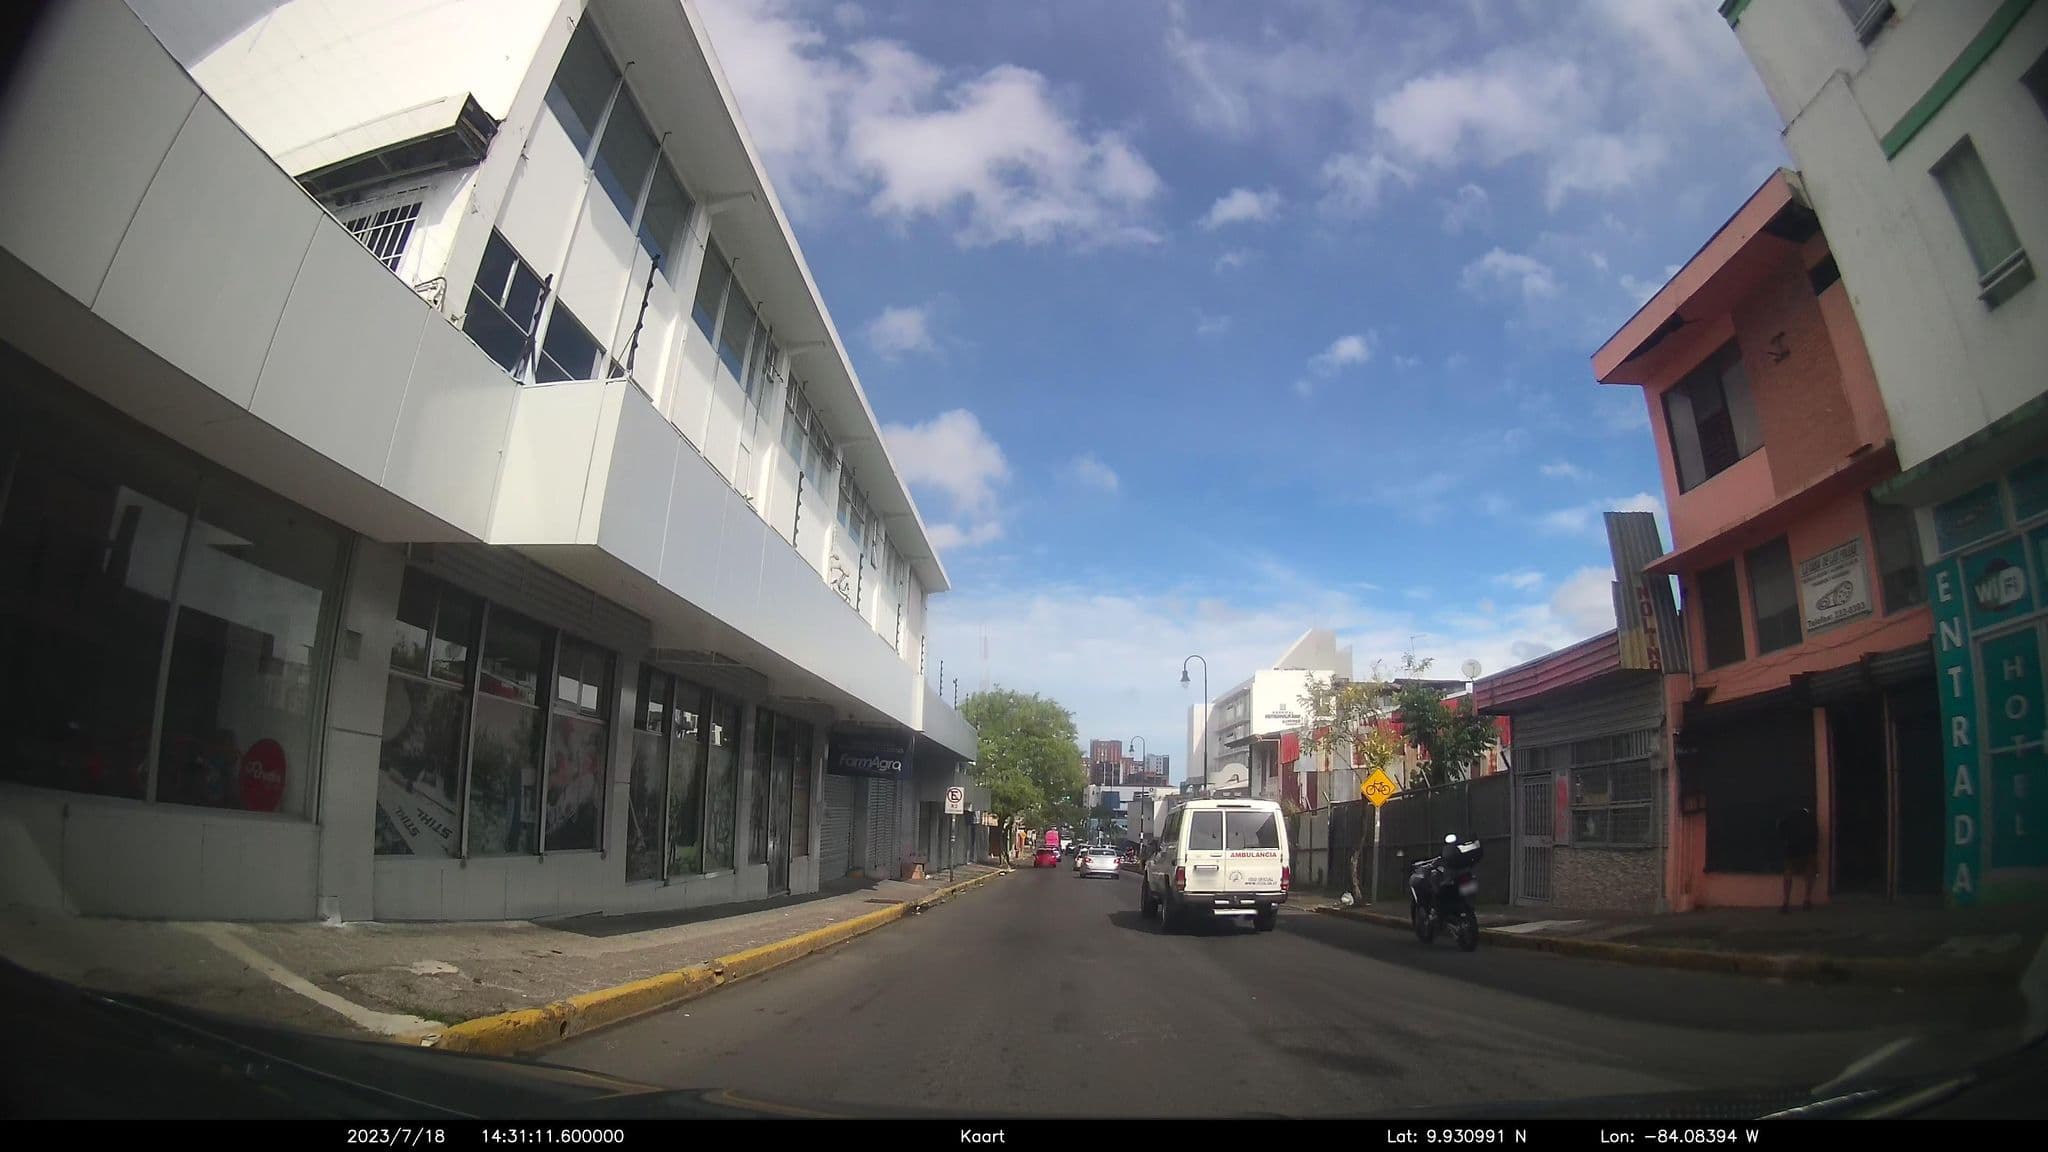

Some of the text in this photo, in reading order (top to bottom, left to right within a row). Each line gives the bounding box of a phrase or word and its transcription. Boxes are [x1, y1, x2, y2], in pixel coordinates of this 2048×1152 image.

[1936, 571, 1975, 893] ENTRADA
[2003, 655, 2027, 836] HOTEL
[417, 807, 453, 840] STIHL
